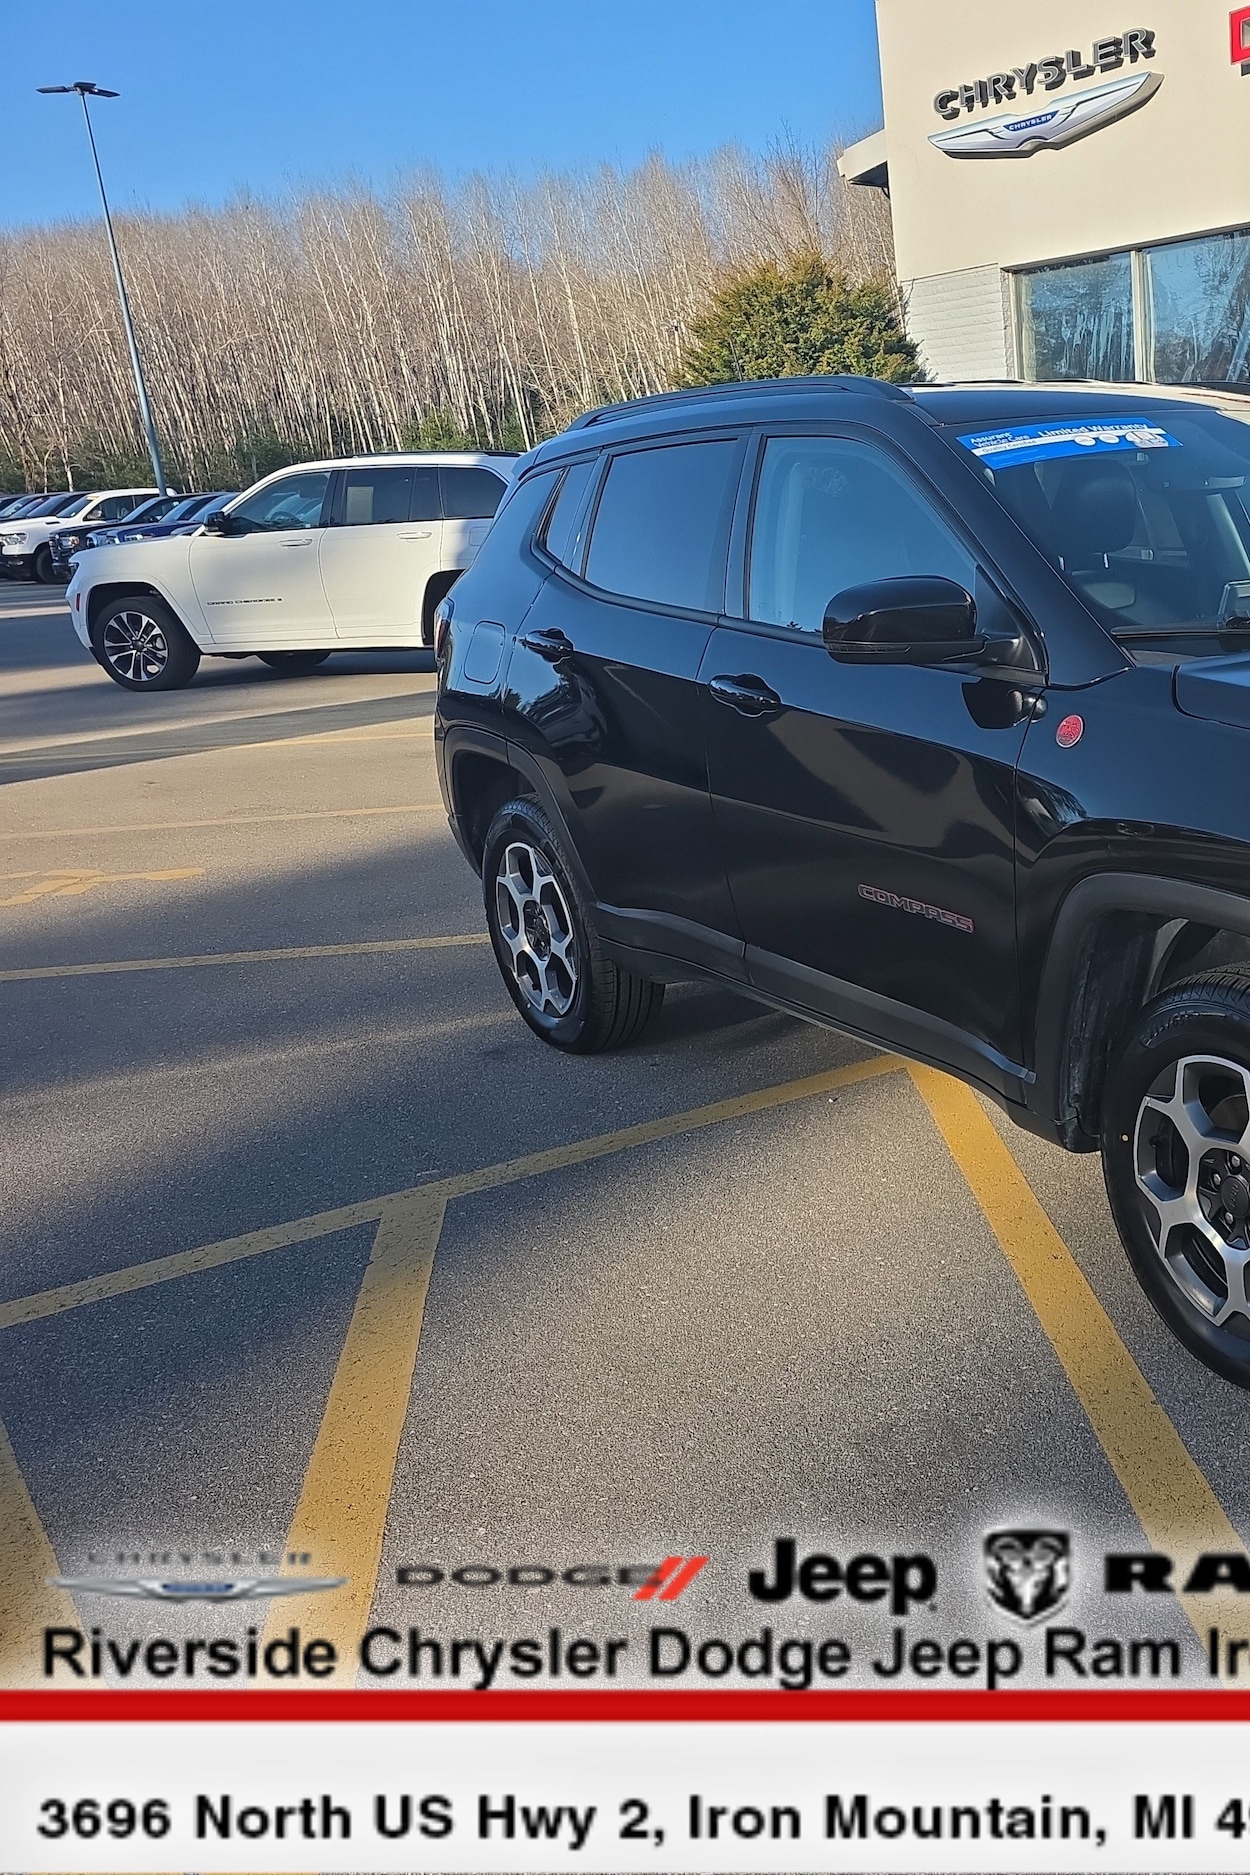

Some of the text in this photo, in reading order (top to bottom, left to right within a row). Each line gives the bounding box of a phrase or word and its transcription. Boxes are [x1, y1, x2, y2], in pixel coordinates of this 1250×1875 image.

[933, 27, 1156, 120] CHRYSLER
[1008, 114, 1053, 131] CHRYSLER
[970, 431, 1012, 444] Assurant
[1037, 423, 1149, 438] Limited Warranty
[858, 883, 974, 934] COMPASS
